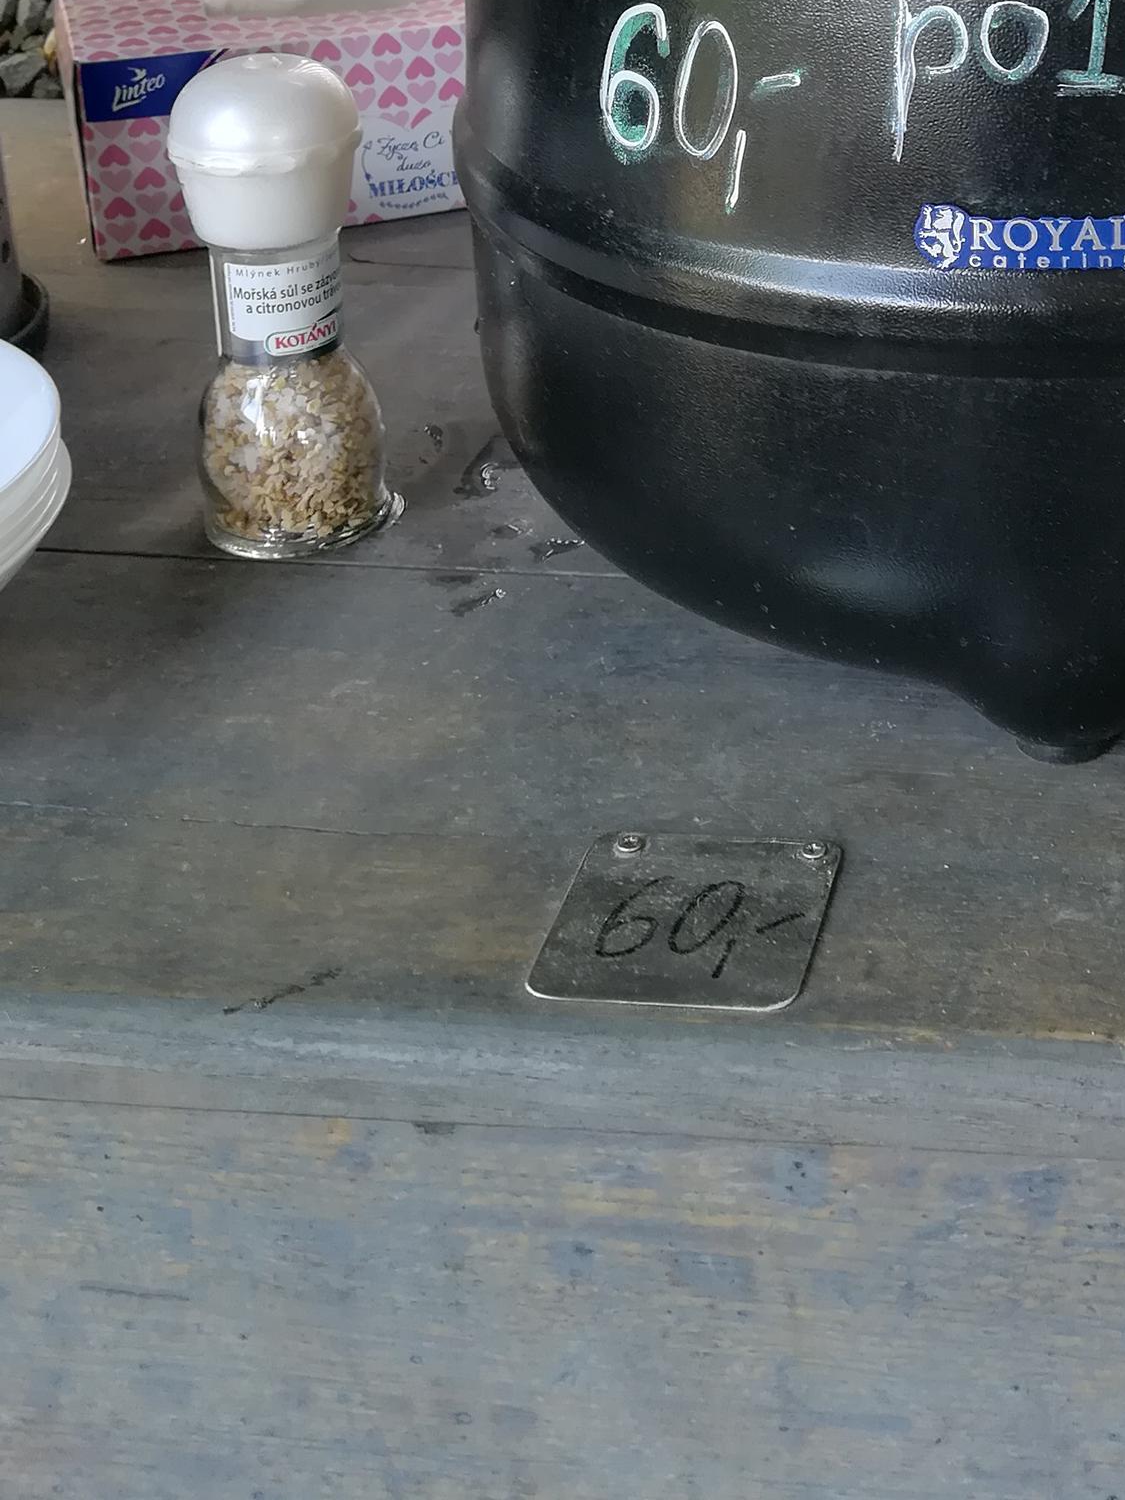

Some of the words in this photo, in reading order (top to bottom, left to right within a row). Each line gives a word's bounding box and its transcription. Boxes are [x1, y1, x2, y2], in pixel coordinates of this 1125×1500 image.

[111, 72, 166, 112] Linteo
[600, 2, 802, 214] 60,-
[235, 267, 281, 279] Mlýnek
[232, 285, 278, 301] Mořská
[280, 286, 299, 299] sůl
[301, 283, 313, 294] se
[246, 304, 253, 314] a
[256, 295, 322, 314] citronovou
[275, 320, 337, 350] KOTÁNYI
[594, 874, 805, 980] 60,-
